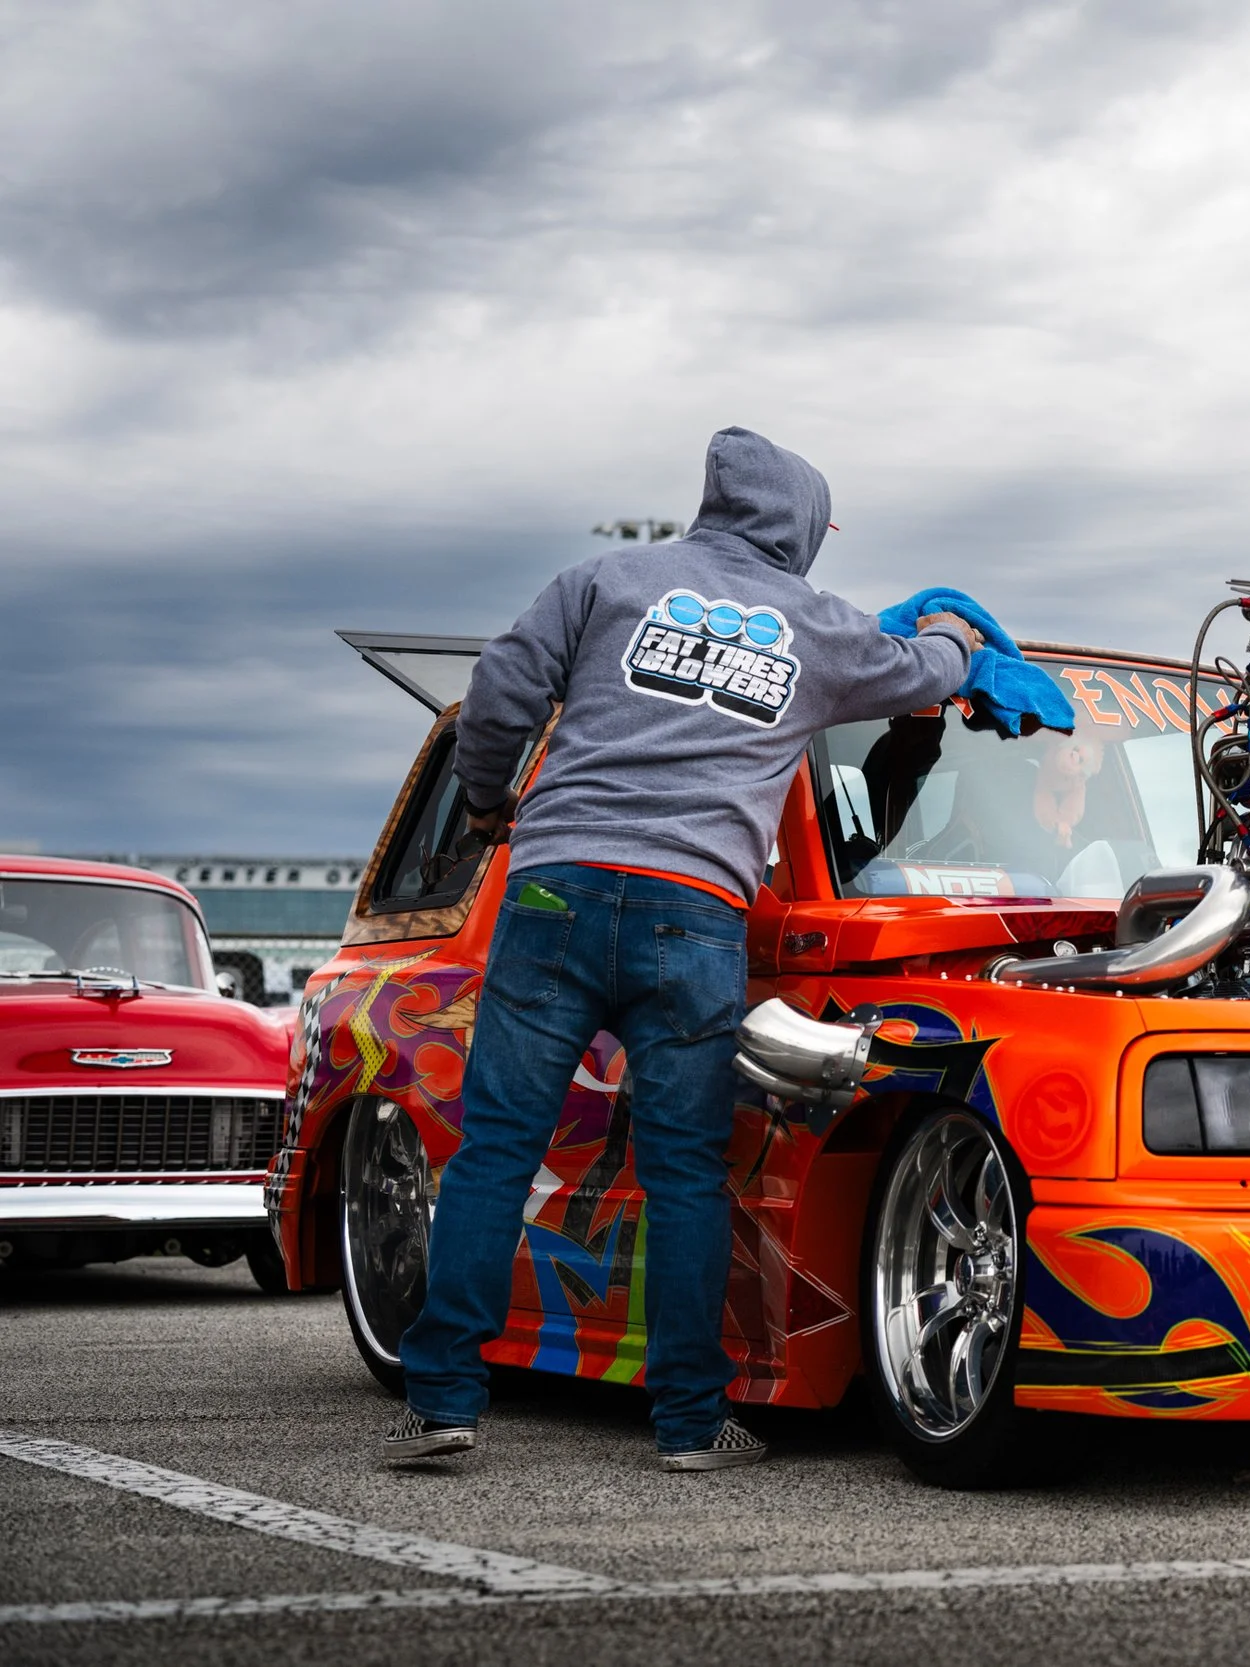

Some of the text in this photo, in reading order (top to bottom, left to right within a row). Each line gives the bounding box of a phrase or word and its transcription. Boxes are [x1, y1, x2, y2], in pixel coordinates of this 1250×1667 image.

[640, 626, 703, 657] FAT
[704, 639, 793, 685] TIRES
[638, 649, 788, 708] BLOWERS
[176, 867, 300, 884] CENTER
[904, 867, 1004, 896] NOS
